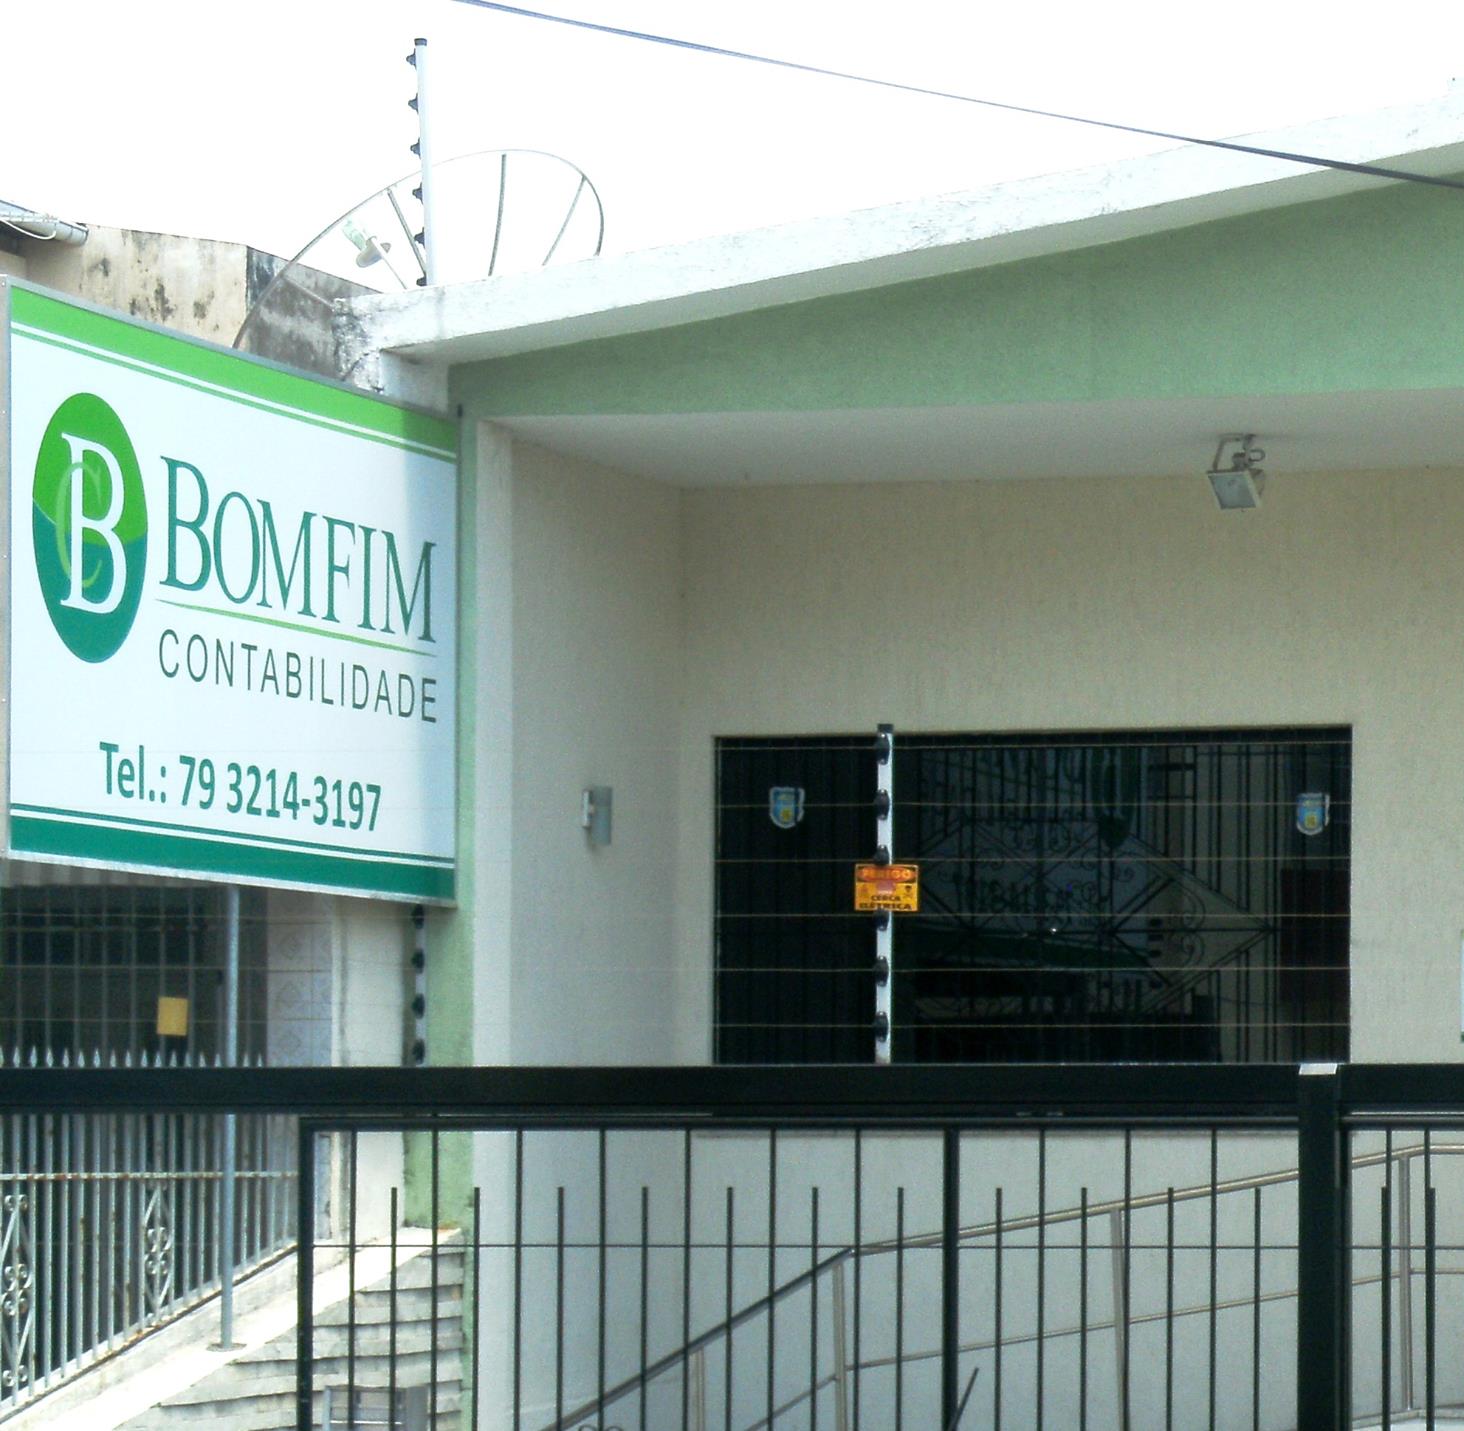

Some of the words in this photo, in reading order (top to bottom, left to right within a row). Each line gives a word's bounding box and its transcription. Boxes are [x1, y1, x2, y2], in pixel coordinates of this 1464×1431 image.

[159, 455, 437, 644] BOMFIM
[159, 629, 437, 723] CONTABILIDADE
[100, 741, 167, 803] Tel.:
[179, 755, 216, 810] 79
[227, 762, 382, 832] 3214-3197
